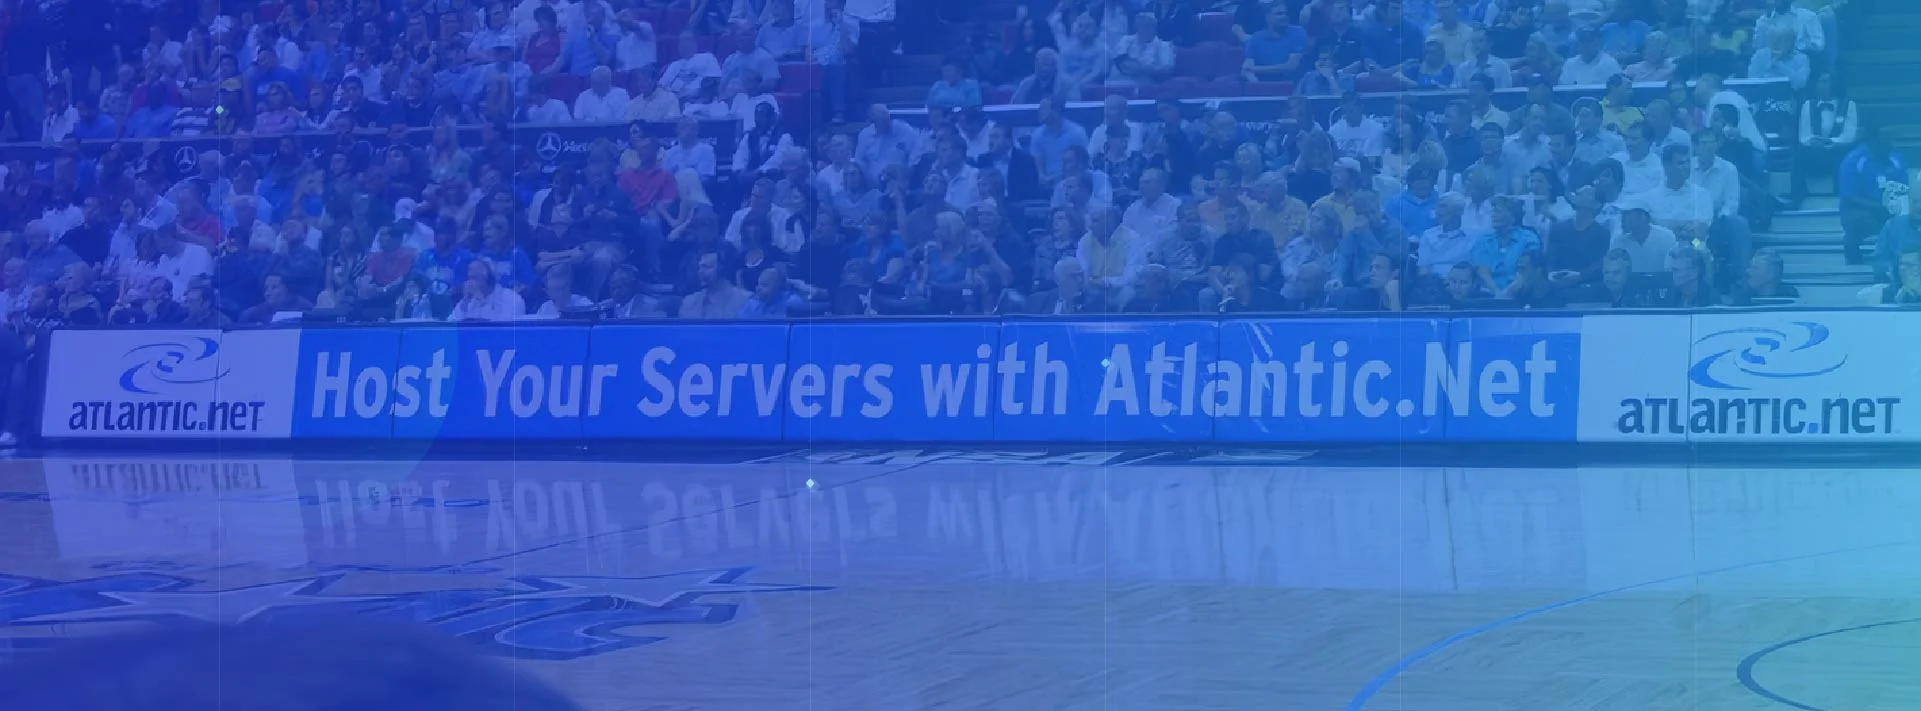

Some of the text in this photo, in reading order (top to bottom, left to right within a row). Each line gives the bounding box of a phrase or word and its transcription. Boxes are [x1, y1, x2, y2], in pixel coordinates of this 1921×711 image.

[311, 341, 1557, 418] Host Your Servers with Atlantic.Net
